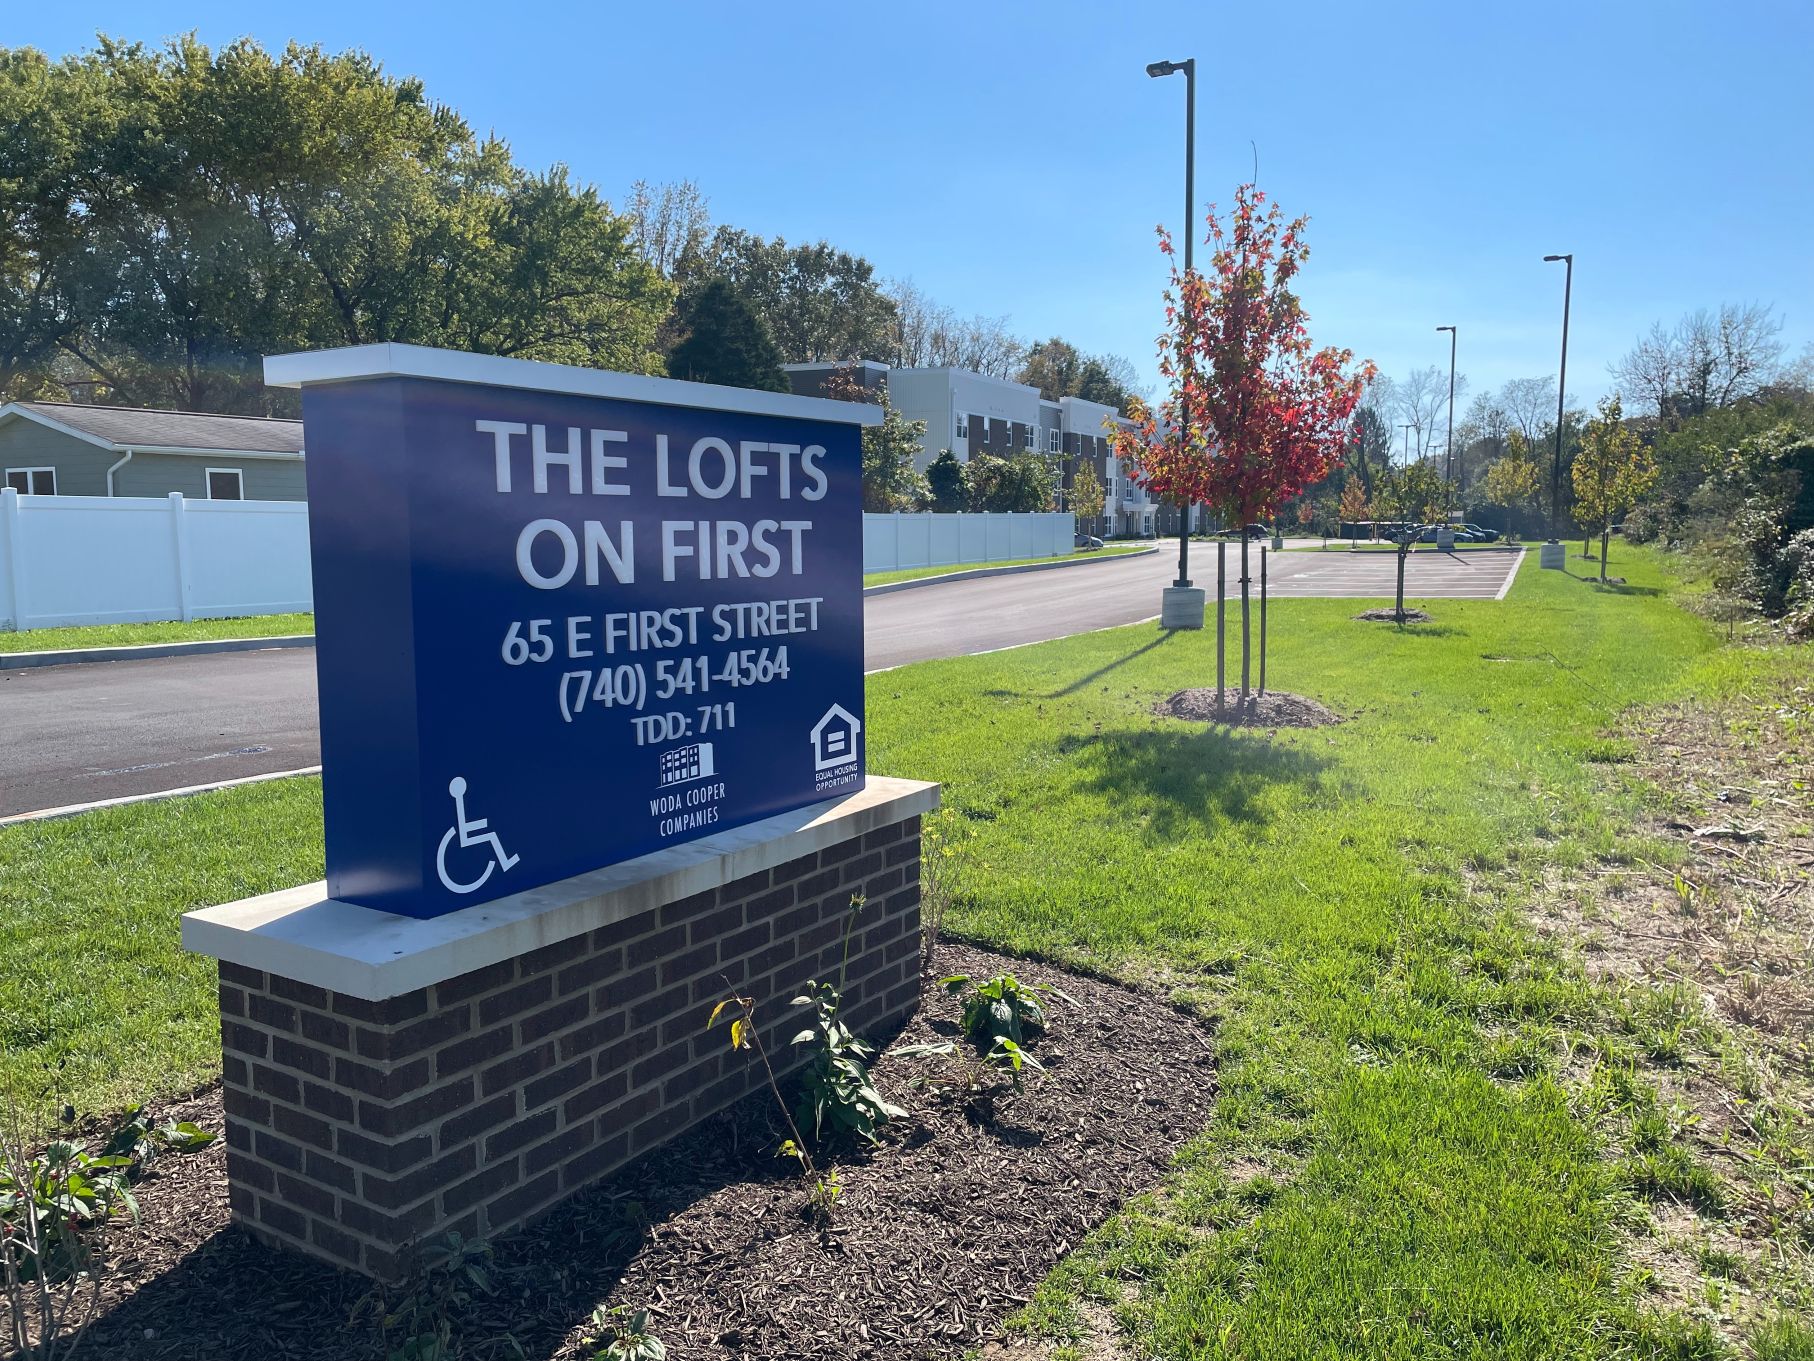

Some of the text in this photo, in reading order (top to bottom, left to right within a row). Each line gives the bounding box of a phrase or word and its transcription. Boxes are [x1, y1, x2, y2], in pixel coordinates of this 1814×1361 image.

[475, 419, 828, 501] THE LOFTS
[516, 518, 813, 590] ON FIRST
[502, 597, 823, 666] 65 E FIRST STREET
[559, 645, 790, 723] (740) 541-4564
[630, 701, 736, 746] TDD: 711
[815, 763, 858, 782] EQUAL HOUSING
[815, 773, 858, 792] OPPORTUNITY
[650, 782, 726, 817] WODA COOPER
[659, 806, 719, 837] COMPANIES
